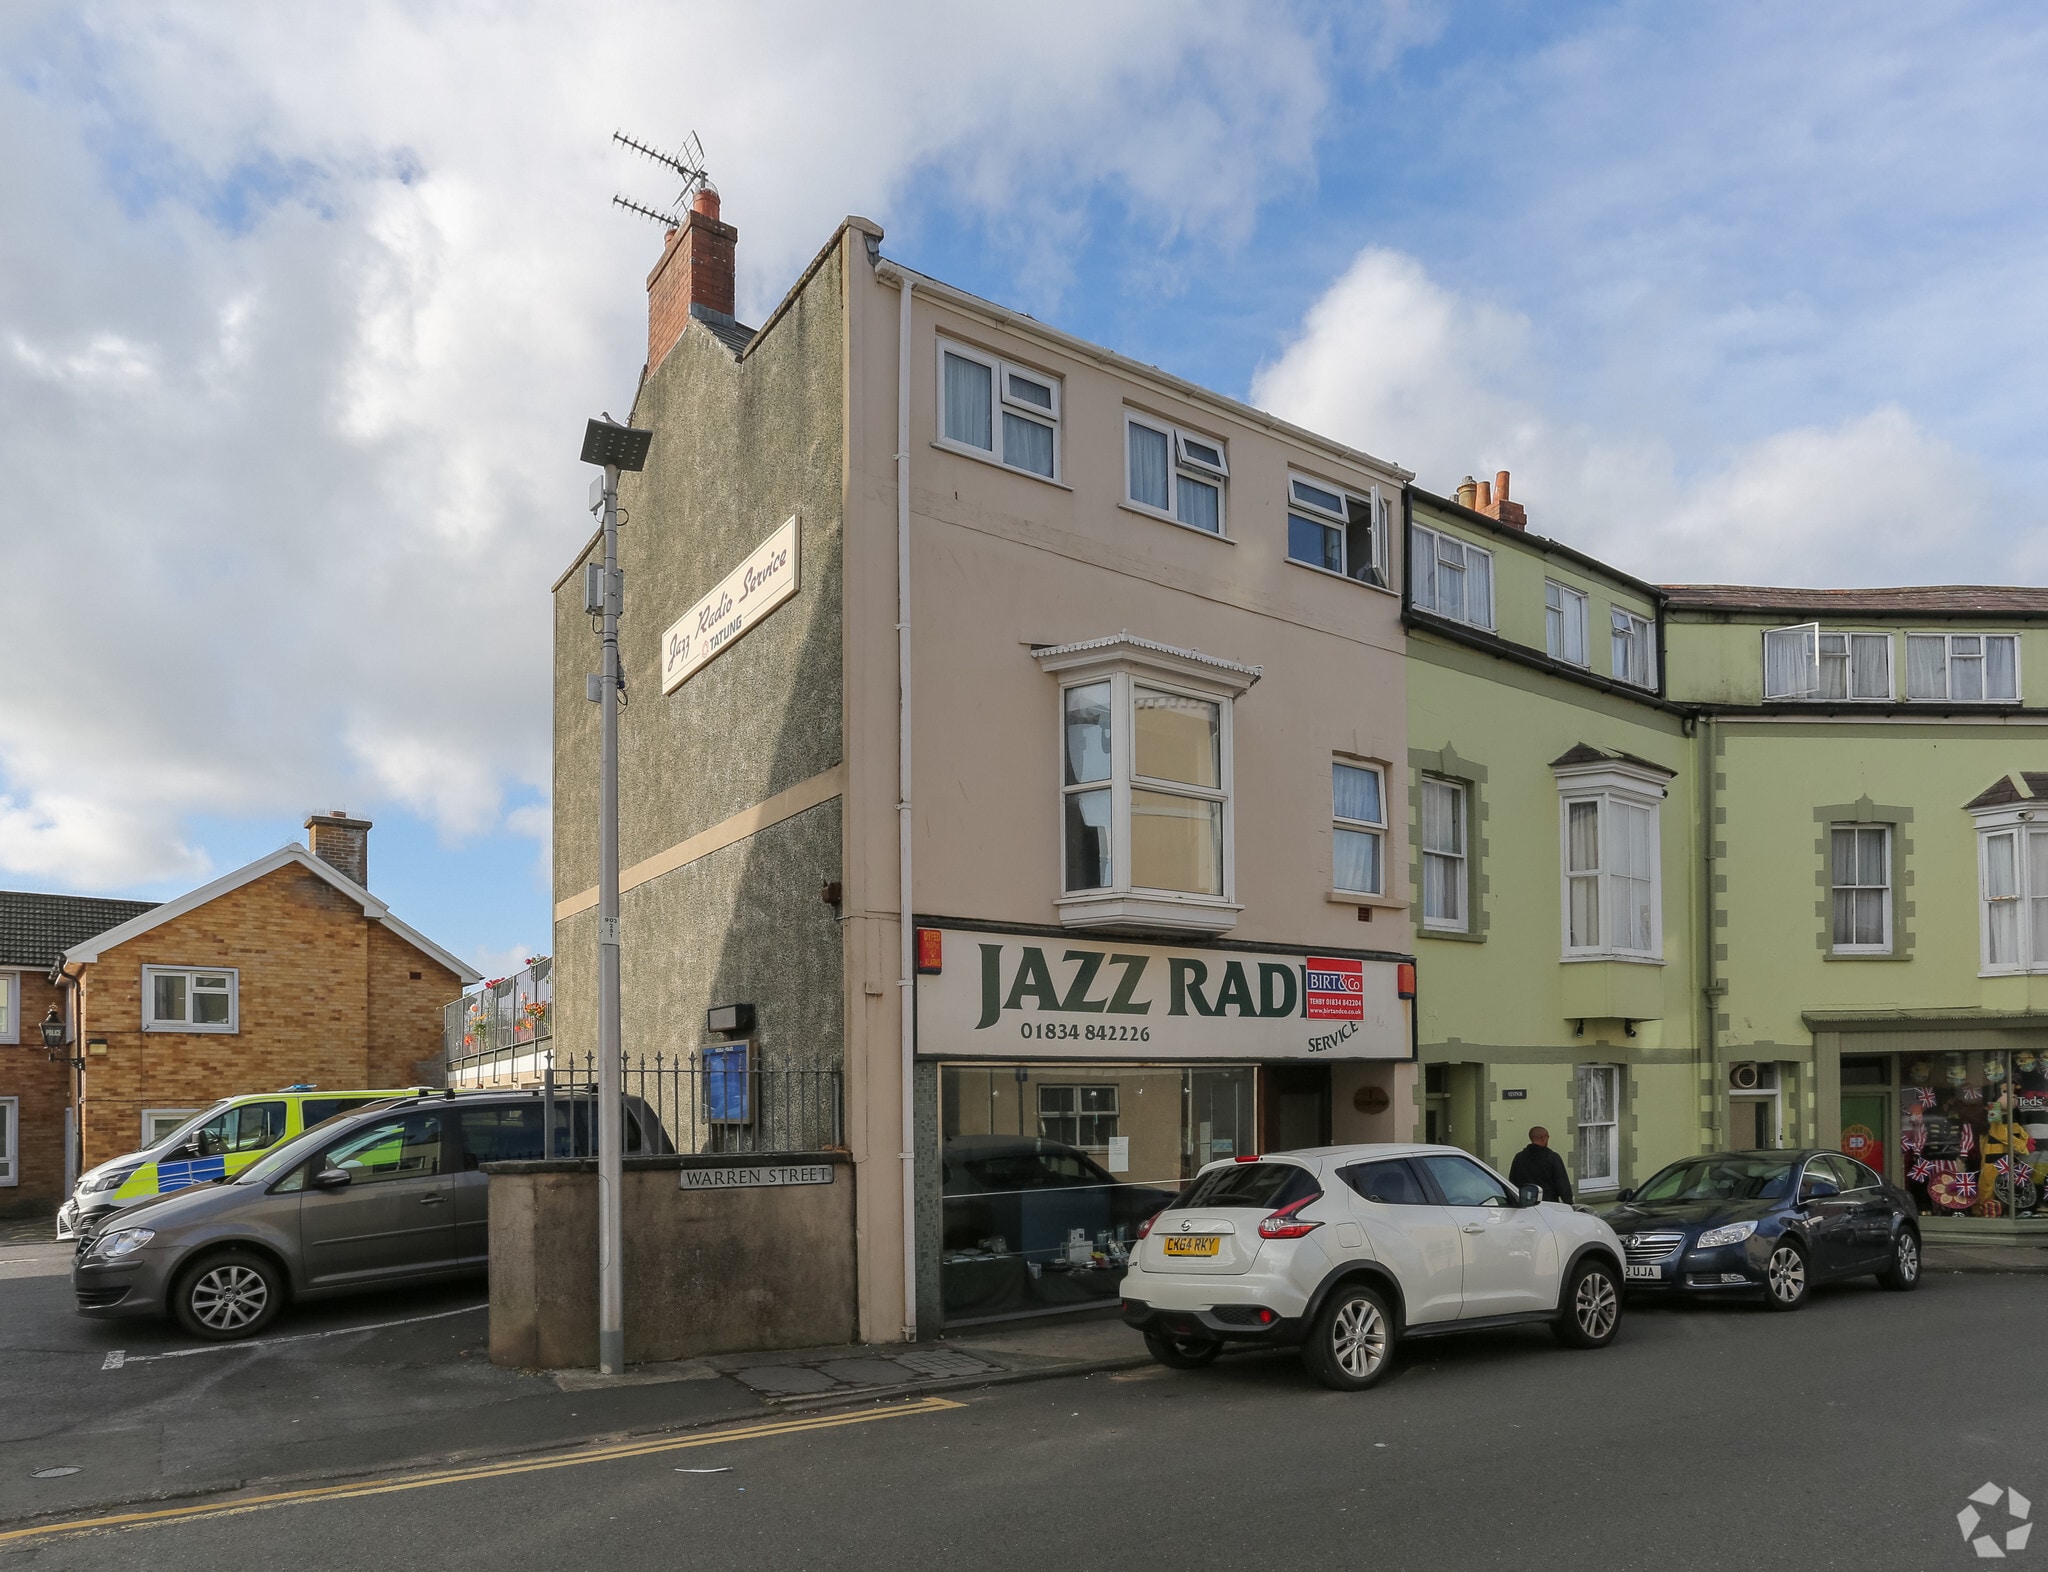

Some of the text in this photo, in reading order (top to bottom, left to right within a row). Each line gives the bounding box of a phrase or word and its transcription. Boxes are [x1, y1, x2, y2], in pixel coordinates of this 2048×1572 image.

[667, 549, 787, 672] Jazz Radio Service
[709, 614, 742, 651] TATUNG
[924, 931, 940, 942] DYFED
[974, 943, 1152, 1030] JAZZ
[1310, 973, 1360, 991] BIRT&Co
[1310, 1007, 1361, 1015] www.birtandco.co.uk
[1326, 998, 1342, 1006] 01834
[45, 1029, 61, 1037] POLICE
[1020, 1022, 1150, 1042] 01834 842226
[1308, 1021, 1358, 1052] SERVICE
[687, 1167, 828, 1185] WARREN STREET
[1167, 1237, 1216, 1251] CK64 RKY
[1633, 1266, 1655, 1277] UJA
